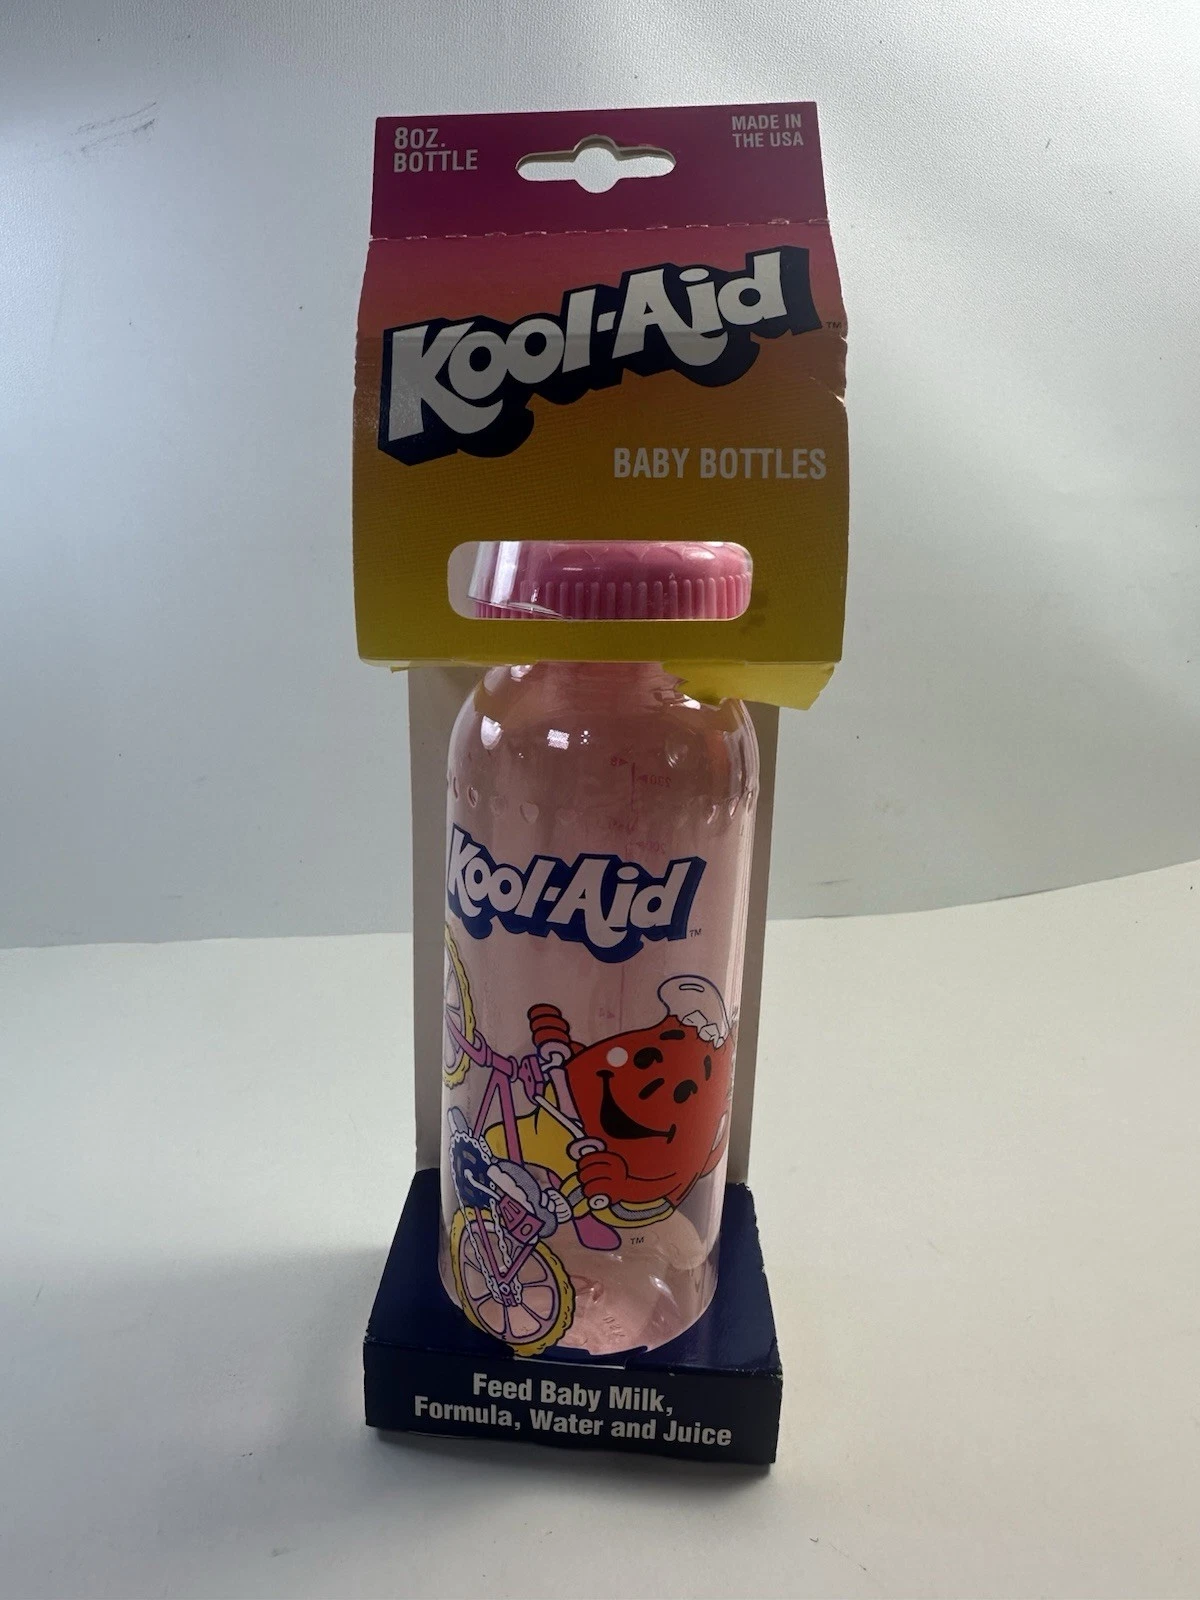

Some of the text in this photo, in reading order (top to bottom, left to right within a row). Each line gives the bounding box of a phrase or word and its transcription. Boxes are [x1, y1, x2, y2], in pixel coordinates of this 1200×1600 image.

[731, 113, 802, 131] MADE IN
[732, 130, 804, 148] THE USA
[393, 149, 479, 173] BOTTLE
[379, 246, 821, 465] Kool-Aid
[613, 447, 827, 480] BABY BOTTLES
[448, 823, 707, 963] Kool-Aid
[472, 1372, 674, 1416] Feed Baby Milk,
[414, 1395, 733, 1447] Formula, Water and Juice
